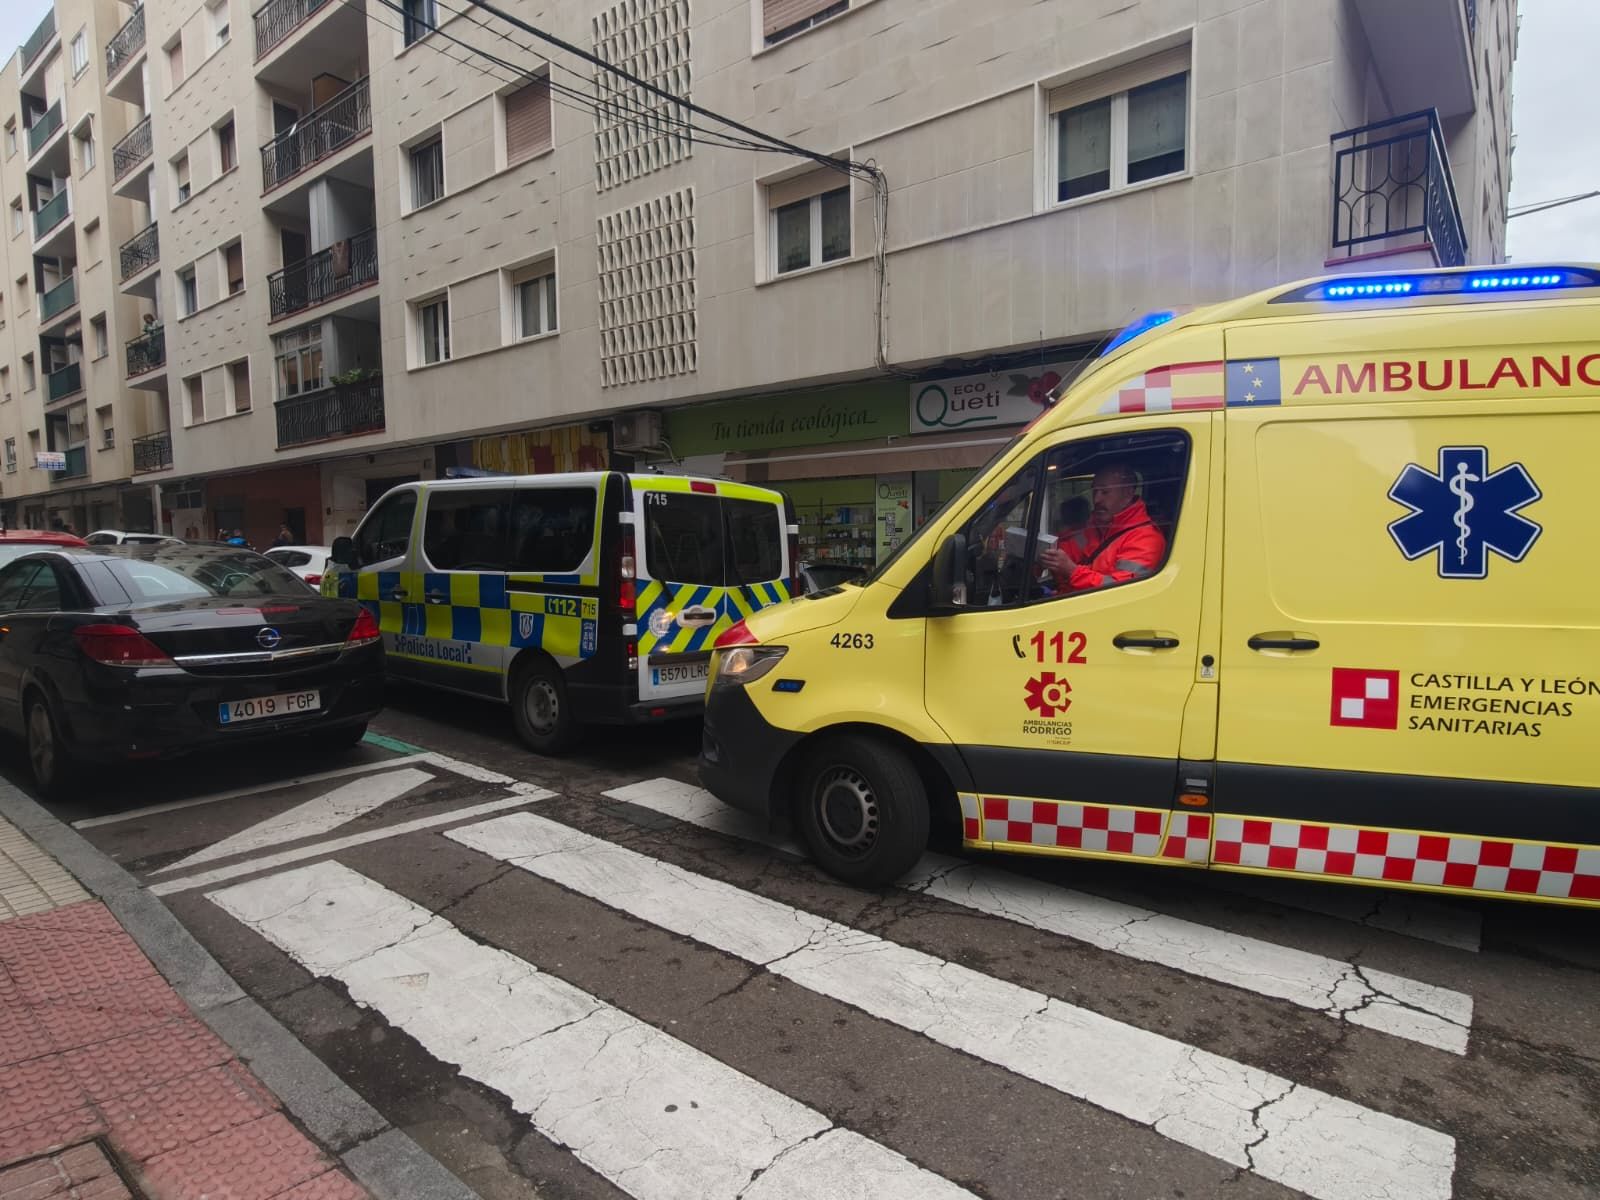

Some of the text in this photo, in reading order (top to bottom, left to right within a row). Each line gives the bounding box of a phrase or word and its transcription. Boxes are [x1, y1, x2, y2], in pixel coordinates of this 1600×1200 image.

[953, 382, 986, 396] ECO
[916, 384, 1000, 427] Queti
[711, 403, 877, 441] Tu tienda ecológica
[646, 493, 668, 506] 715
[552, 599, 577, 616] 112
[582, 602, 597, 617] 715
[830, 632, 874, 649] 4263
[1030, 630, 1087, 665] 112
[437, 641, 465, 663] Local
[660, 666, 688, 682] 5570
[1410, 672, 1600, 696] CASTILLA Y LEÓN
[233, 693, 315, 719] 4019 FGP
[1409, 694, 1573, 717] EMERGENCIAS
[1023, 719, 1073, 728] AMBULANCIAS
[1023, 725, 1072, 736] RODRIGO
[1408, 715, 1542, 737] SANITARIAS
